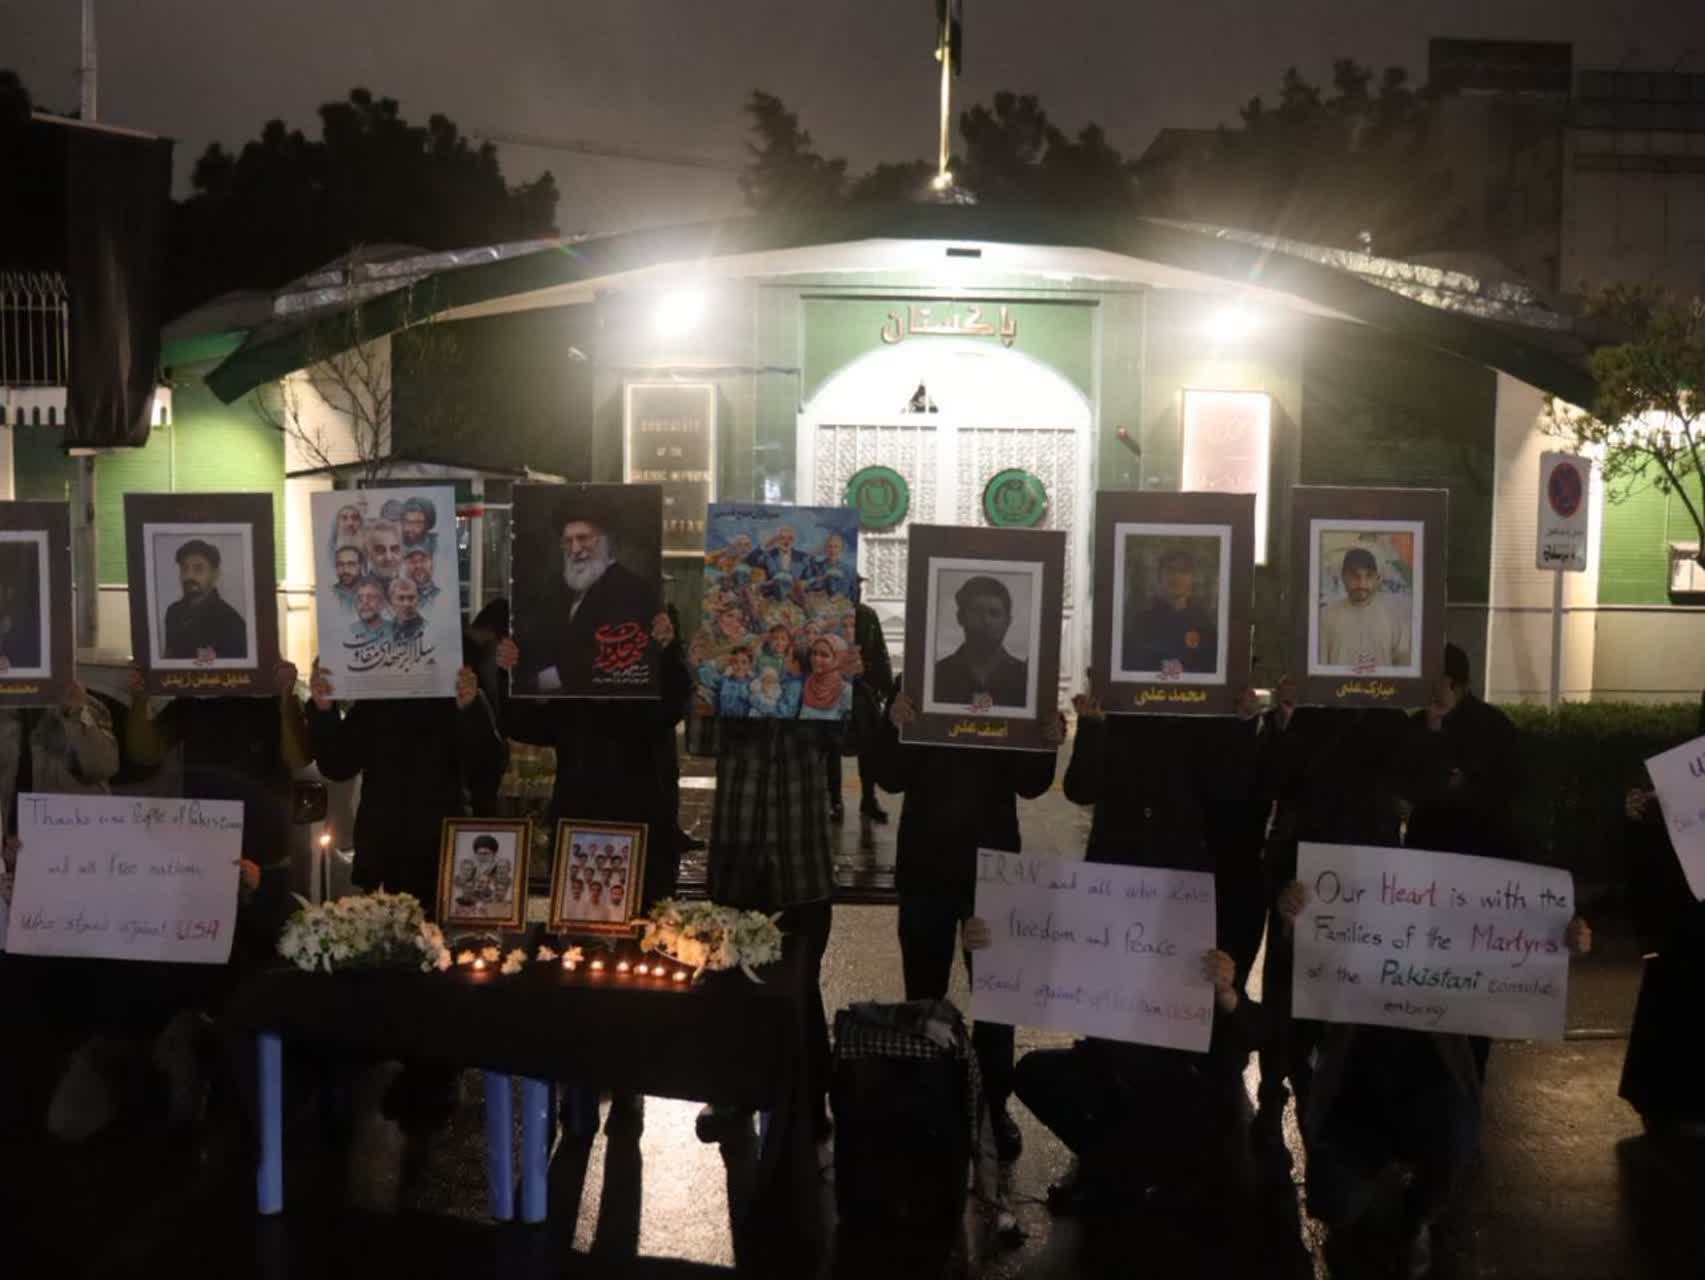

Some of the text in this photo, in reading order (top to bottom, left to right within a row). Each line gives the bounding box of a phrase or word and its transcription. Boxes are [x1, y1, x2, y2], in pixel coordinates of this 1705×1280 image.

[879, 303, 1017, 348] پاکستان
[1167, 688, 1207, 703] محمد
[980, 853, 1042, 886] IRAN
[1048, 872, 1078, 891] and
[1088, 880, 1112, 897] all
[1315, 869, 1569, 913] Our Heart is with the
[1085, 927, 1112, 948] and
[1313, 915, 1561, 969] Families of the Martyrs
[1335, 964, 1363, 986] the
[1379, 958, 1484, 991] Pakistani
